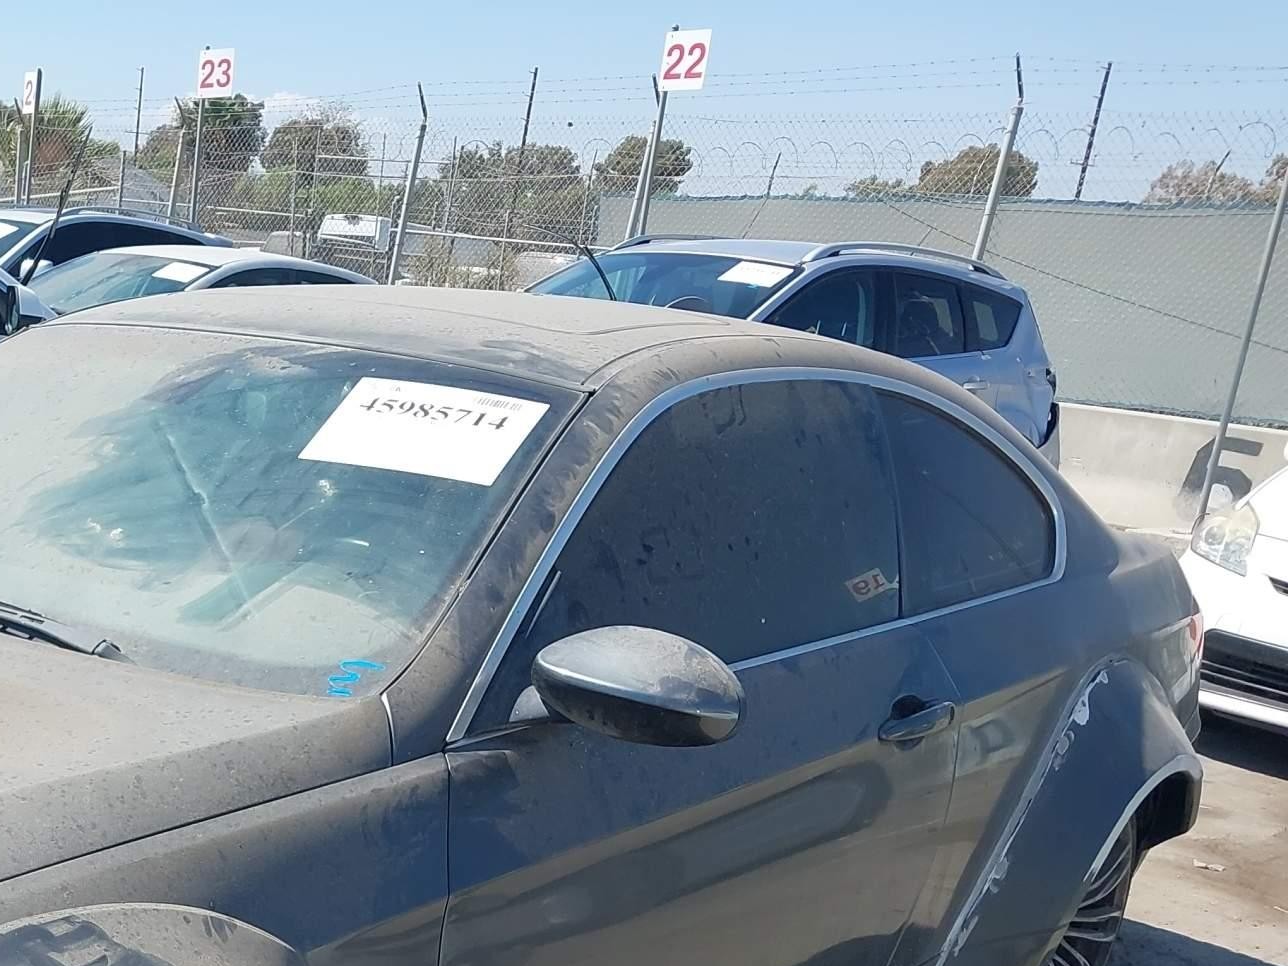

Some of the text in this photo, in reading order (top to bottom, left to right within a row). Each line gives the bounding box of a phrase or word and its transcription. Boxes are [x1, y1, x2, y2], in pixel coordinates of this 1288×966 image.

[200, 58, 231, 88] 23
[663, 42, 706, 80] 22
[24, 79, 35, 106] 2
[360, 397, 509, 430] 45985714
